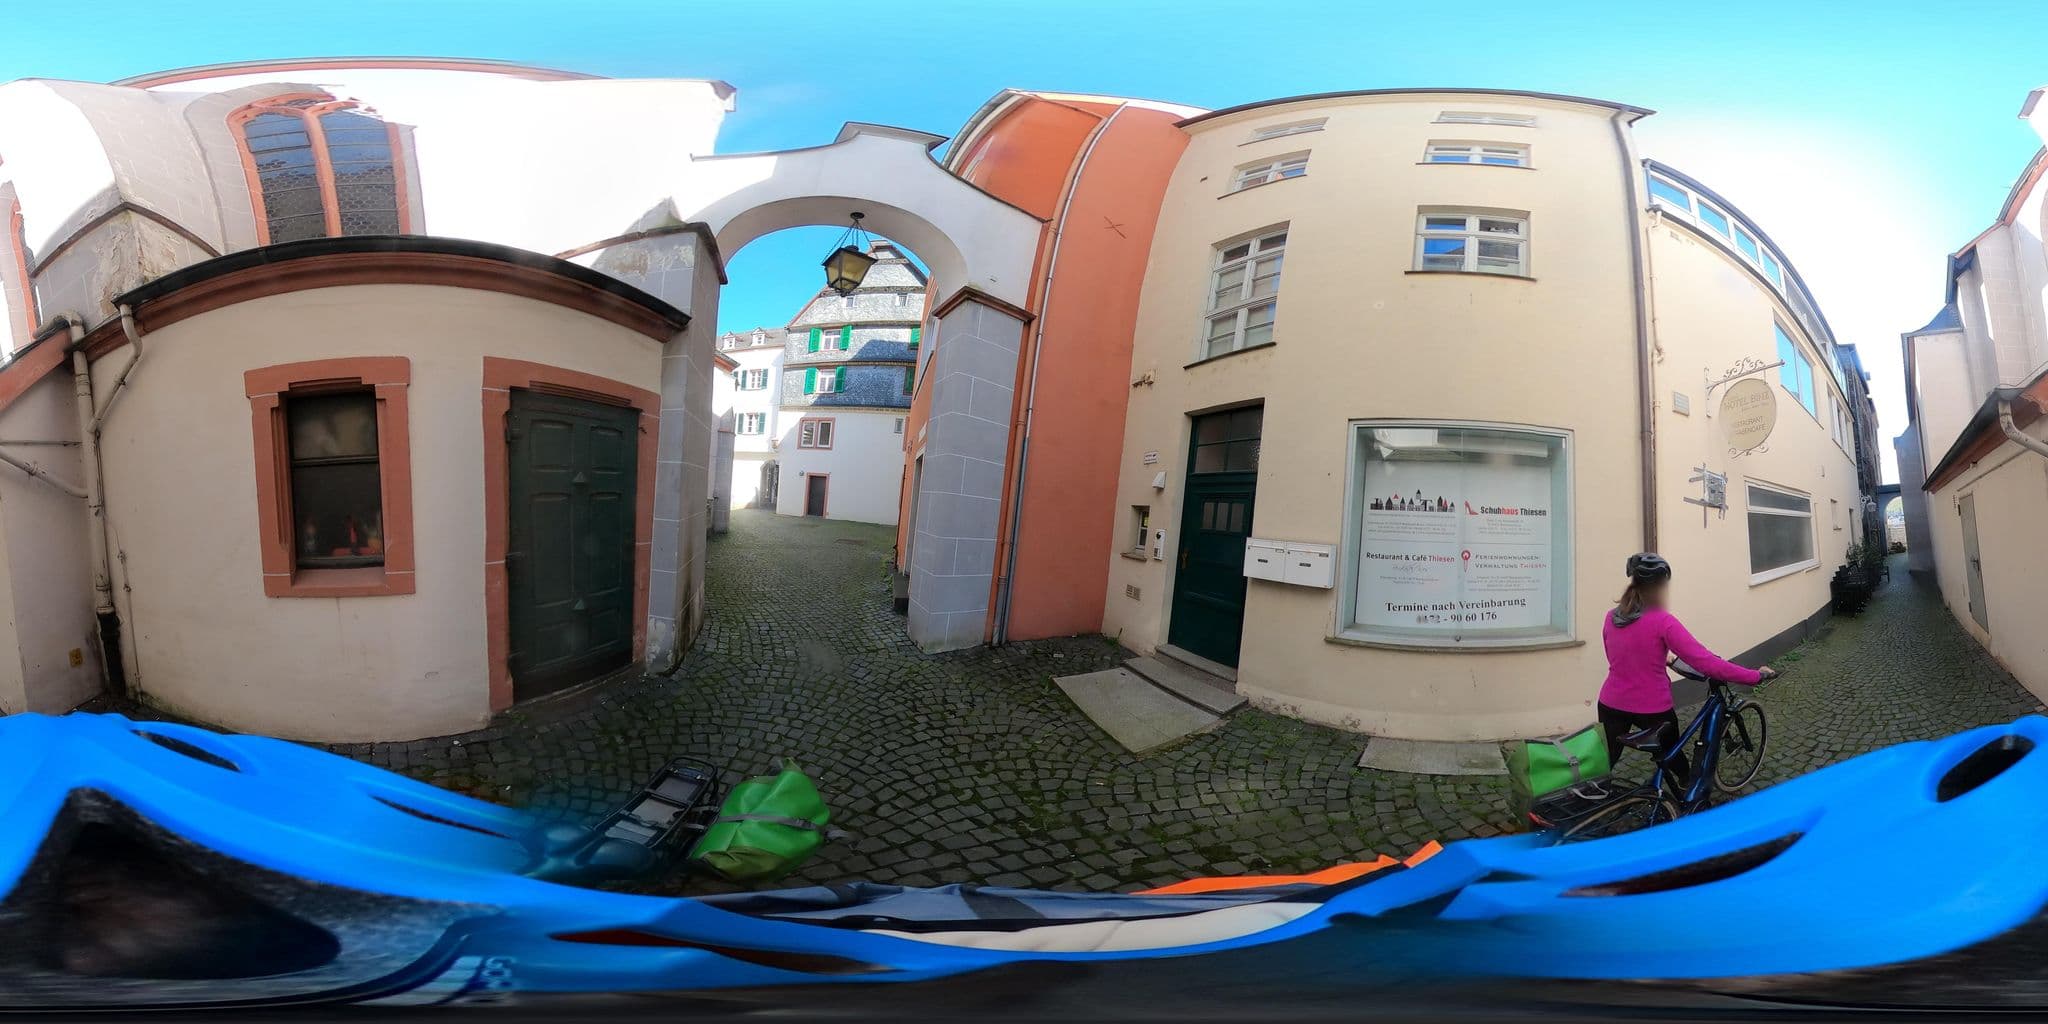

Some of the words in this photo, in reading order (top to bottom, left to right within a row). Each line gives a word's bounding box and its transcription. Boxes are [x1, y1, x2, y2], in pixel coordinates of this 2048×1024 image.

[1480, 505, 1519, 516] Schuhhaus
[1520, 507, 1547, 517] Thiesen
[1366, 552, 1403, 561] Restaurant
[1411, 554, 1427, 562] Café
[1428, 555, 1455, 563] Thiesen
[1385, 602, 1429, 612] Termine
[1431, 601, 1456, 611] nach
[1458, 598, 1527, 611] Vereinbarung
[1450, 614, 1463, 624] 90
[1465, 613, 1477, 622] 60
[1480, 611, 1498, 621] 176
